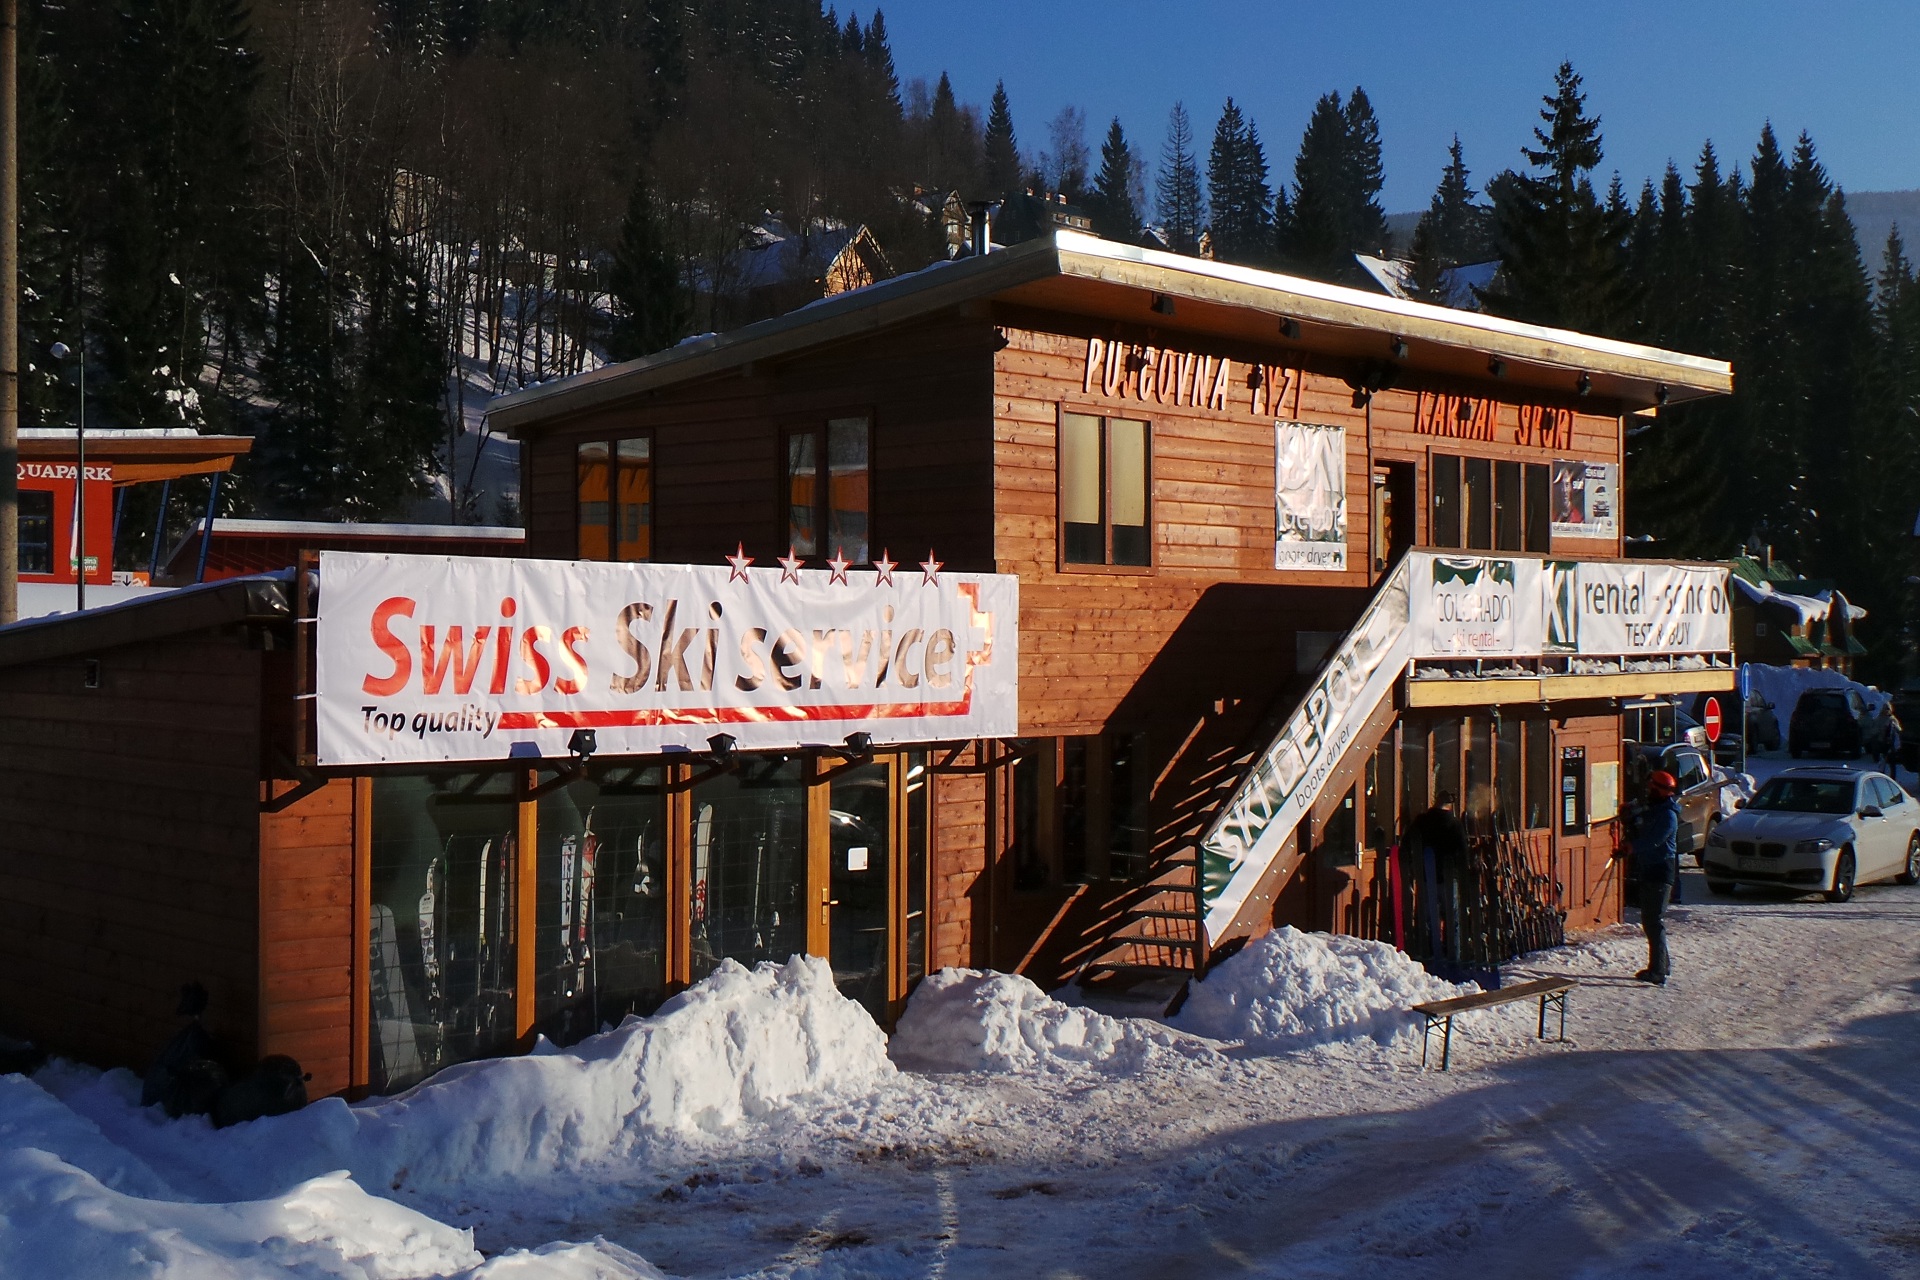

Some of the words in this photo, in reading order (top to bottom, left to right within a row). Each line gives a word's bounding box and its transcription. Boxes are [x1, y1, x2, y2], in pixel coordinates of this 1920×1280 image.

[1516, 404, 1578, 450] SPORT
[1584, 571, 1647, 615] rental
[361, 596, 591, 697] Swiss
[609, 598, 723, 695] Ski
[734, 604, 956, 692] service
[1625, 622, 1653, 647] TEST
[361, 705, 406, 740] Top
[411, 703, 498, 740] quality
[1295, 761, 1327, 810] boots
[1326, 723, 1351, 770] dryer
[1217, 773, 1272, 872] SKI
